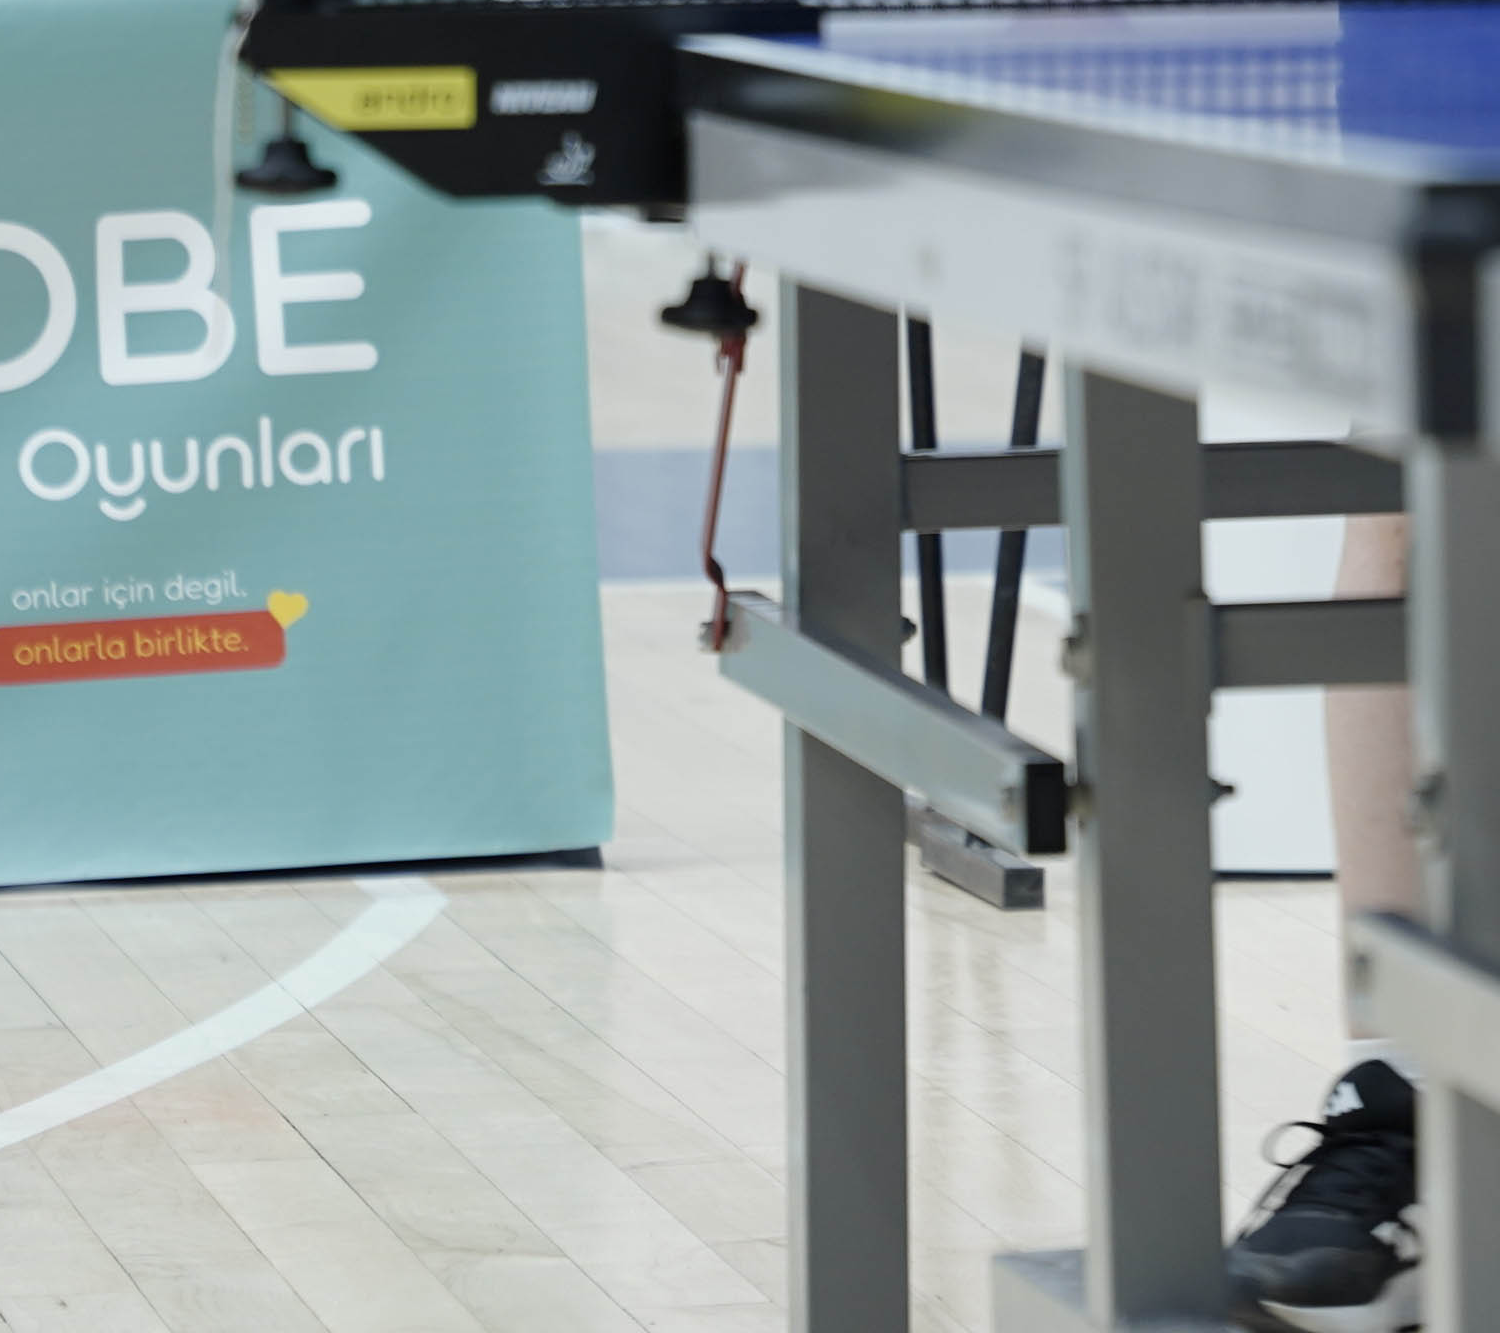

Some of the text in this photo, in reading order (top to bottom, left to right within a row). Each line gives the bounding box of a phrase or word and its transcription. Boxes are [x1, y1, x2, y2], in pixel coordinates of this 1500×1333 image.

[18, 415, 387, 522] Oyunları
[12, 580, 94, 611] onlar
[103, 576, 155, 610] için
[13, 630, 250, 666] onlarla birlikte.
